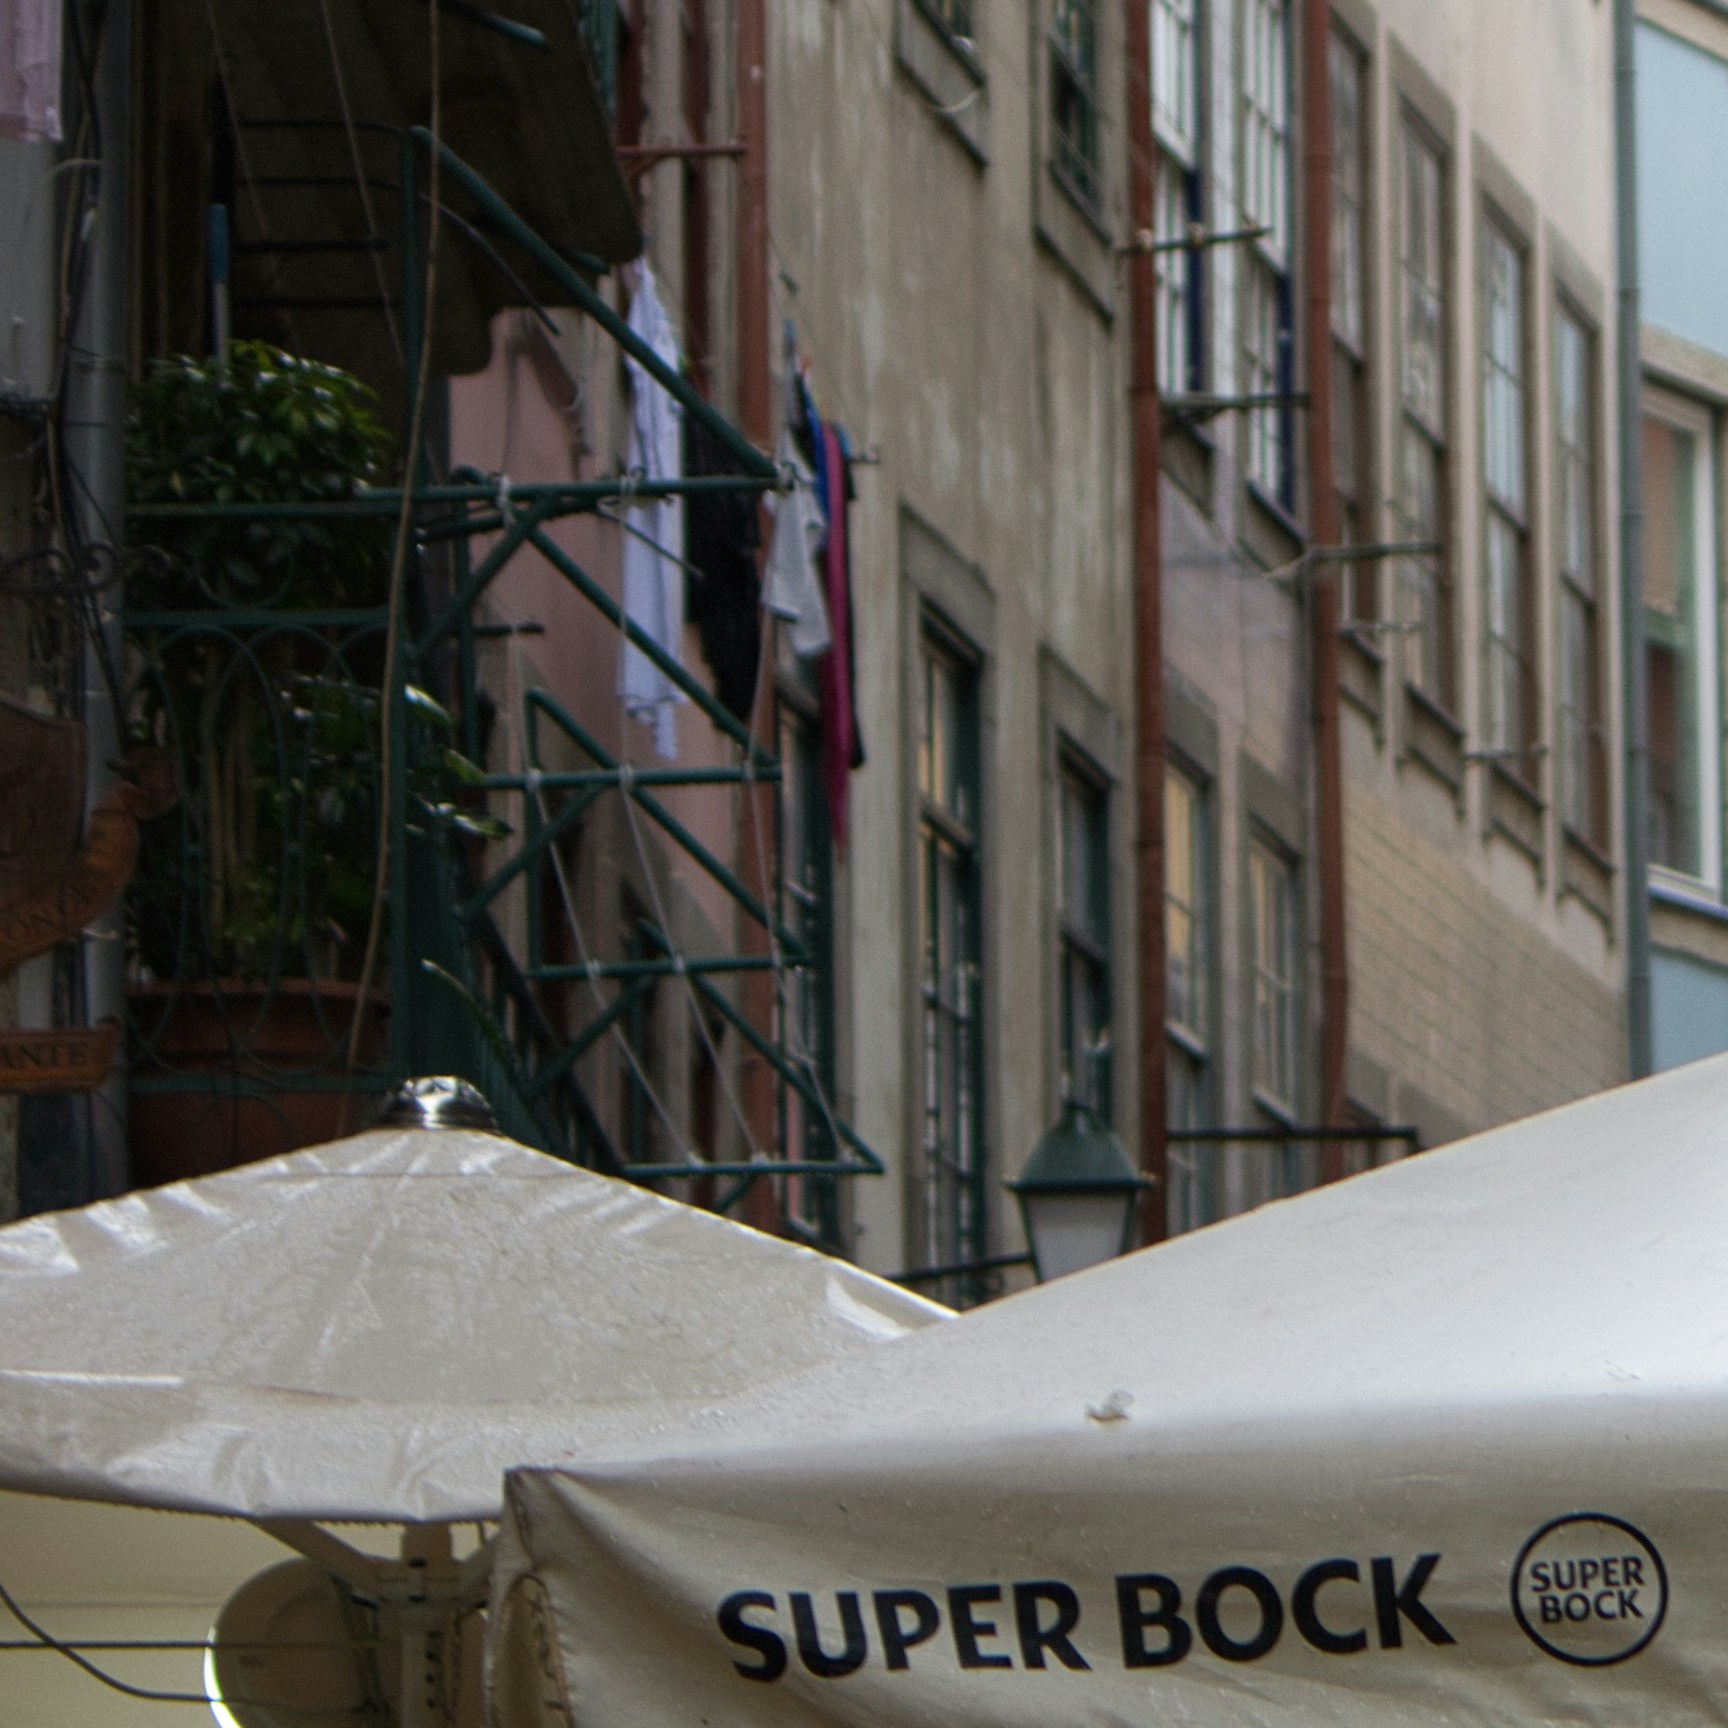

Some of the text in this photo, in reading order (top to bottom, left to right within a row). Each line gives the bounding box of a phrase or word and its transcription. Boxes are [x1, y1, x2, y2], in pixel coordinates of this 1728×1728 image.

[1530, 1554, 1646, 1593] SUPER
[716, 1552, 1459, 1684] SUPER BOCK
[1539, 1588, 1646, 1624] BOCK
